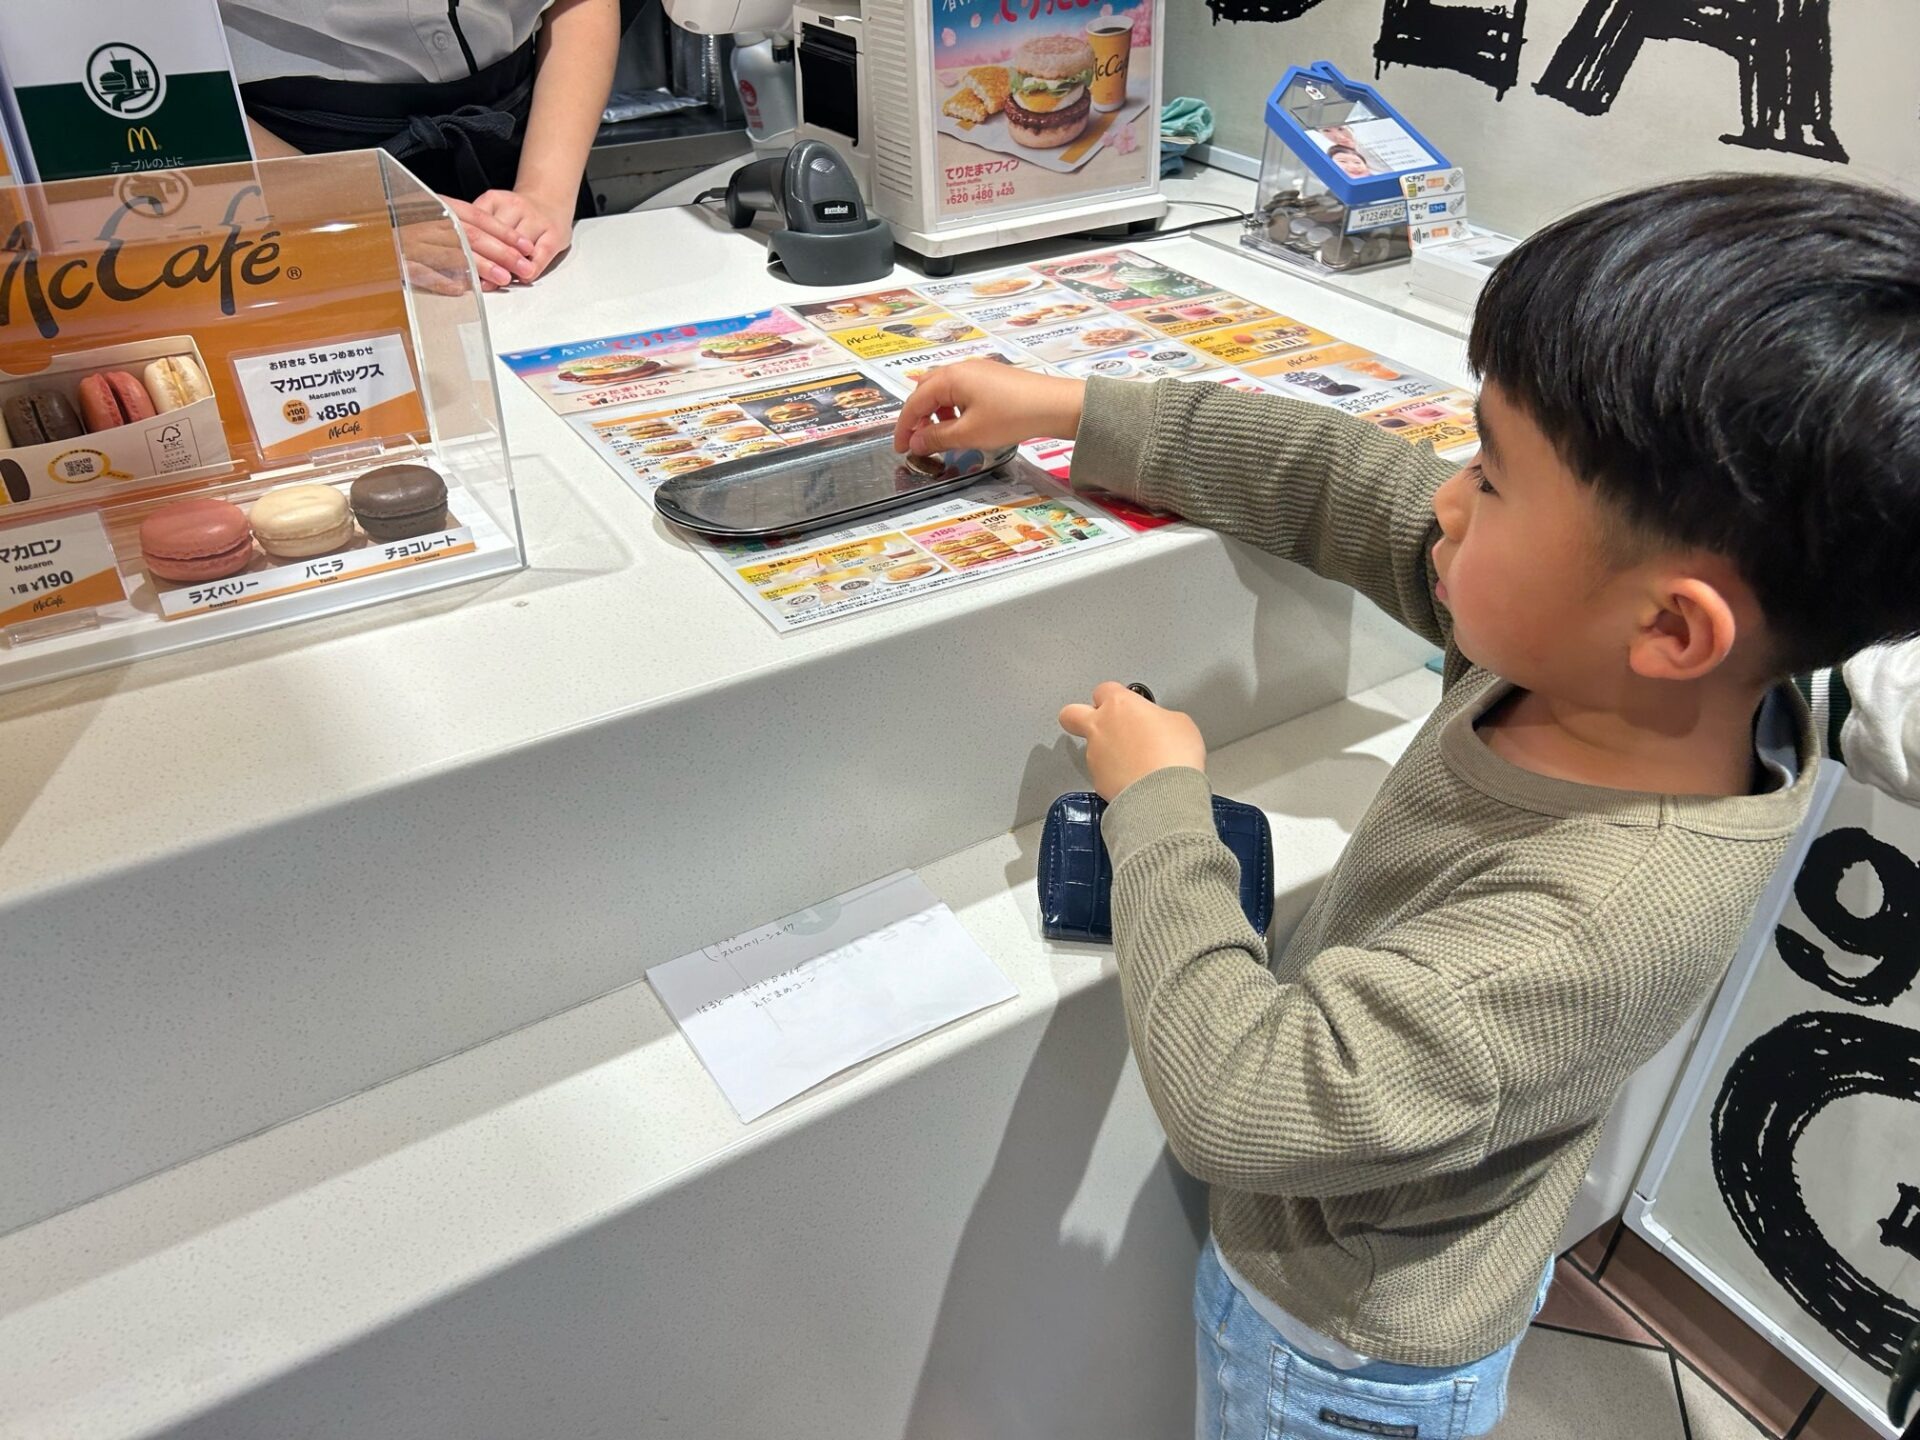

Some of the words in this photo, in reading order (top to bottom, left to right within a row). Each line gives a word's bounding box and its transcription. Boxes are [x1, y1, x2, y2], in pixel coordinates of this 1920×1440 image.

[945, 160, 1019, 180] てりたまマフィン
[946, 193, 968, 204] ¥620
[971, 189, 993, 200] ¥480
[996, 187, 1015, 197] ¥420
[269, 357, 306, 370] お好きな
[308, 353, 328, 364] 5個
[329, 346, 373, 360] つめあわせ
[270, 363, 384, 393] マカロンボックス
[309, 390, 340, 401] Macaron
[341, 387, 357, 395] BOX
[287, 407, 305, 416] ¥100
[316, 401, 361, 422] ¥850
[328, 421, 363, 440] McCafé
[0, 539, 61, 563] マカロン
[385, 535, 457, 559] チョコレート
[14, 560, 54, 572] Macaron
[305, 559, 344, 577] バニラ
[10, 583, 29, 594] 1個
[30, 570, 74, 591] ¥190
[188, 581, 259, 604] ラズベリー
[751, 976, 816, 1008] えだまめコーン
